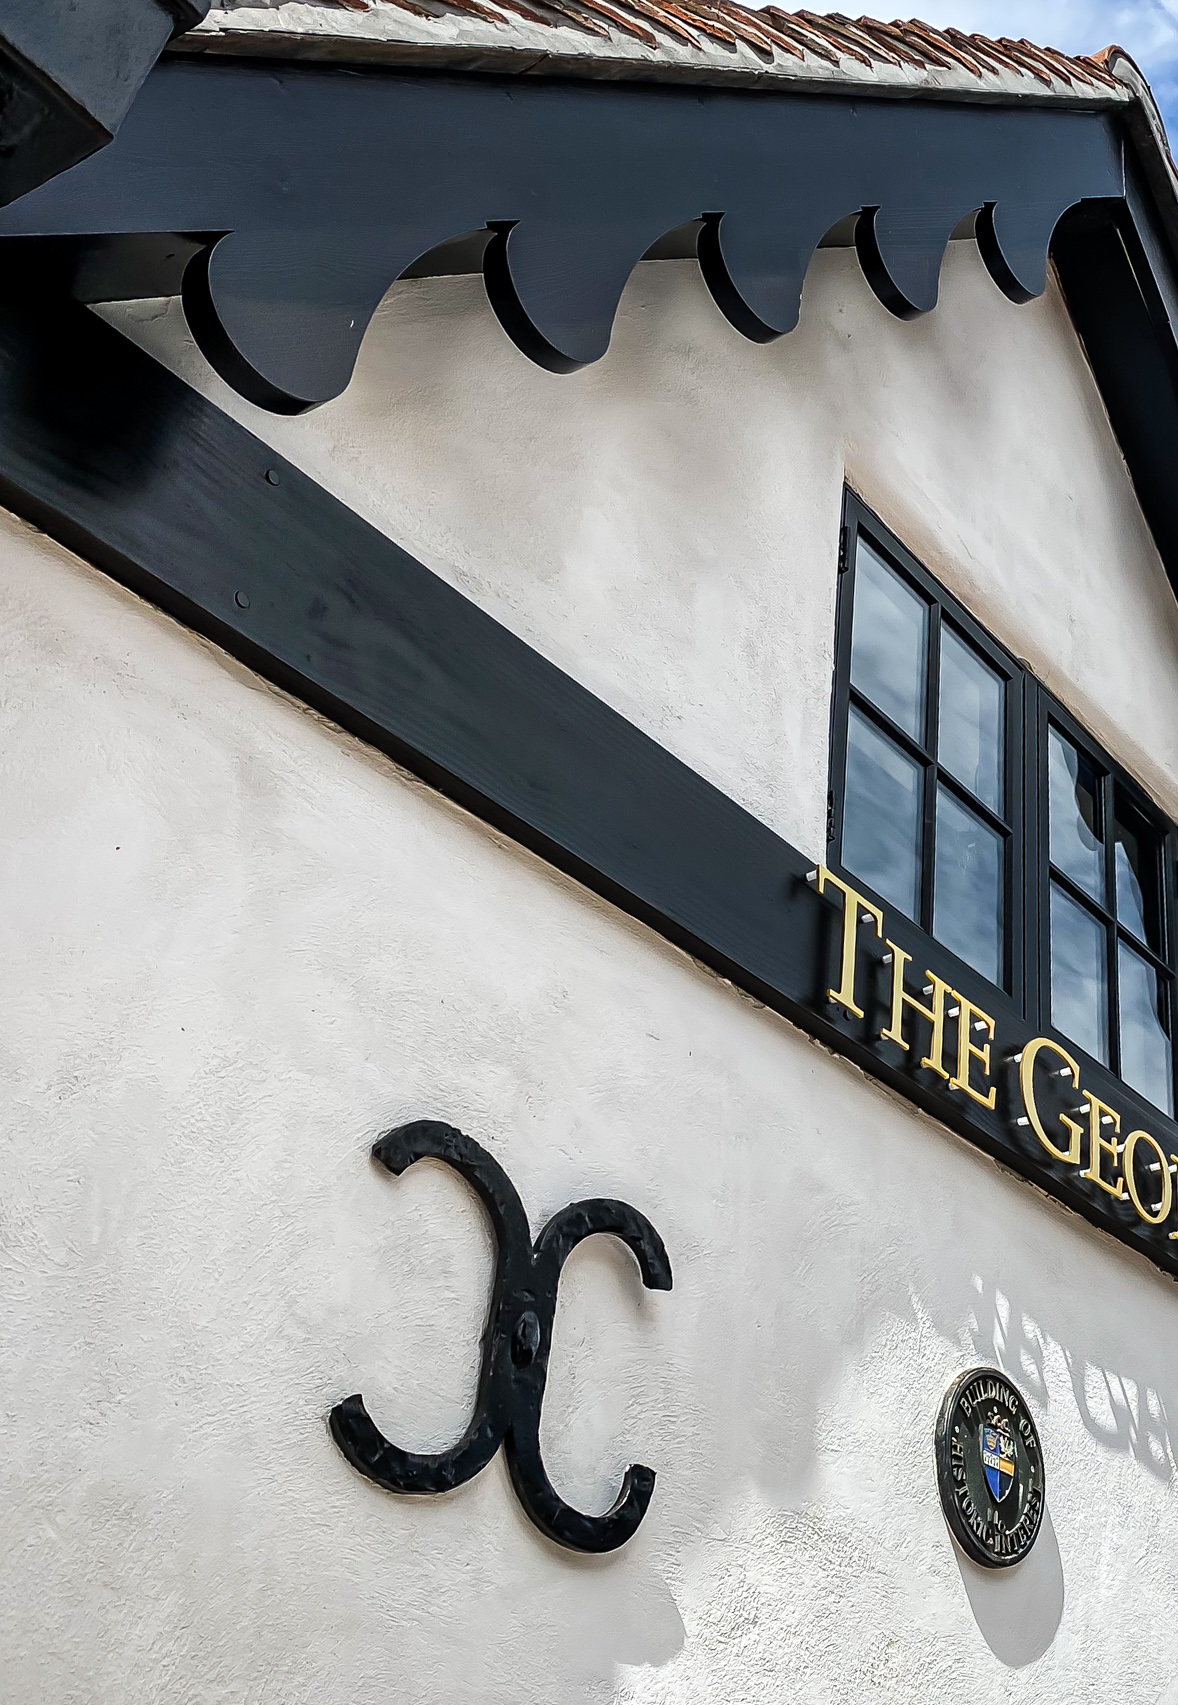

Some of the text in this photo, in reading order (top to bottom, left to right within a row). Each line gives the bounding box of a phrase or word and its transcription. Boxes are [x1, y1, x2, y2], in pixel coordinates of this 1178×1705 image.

[816, 864, 996, 1110] THE
[960, 1379, 1037, 1448] BUILDING OF
[952, 1440, 1042, 1553] HISTORIC INTEREST
